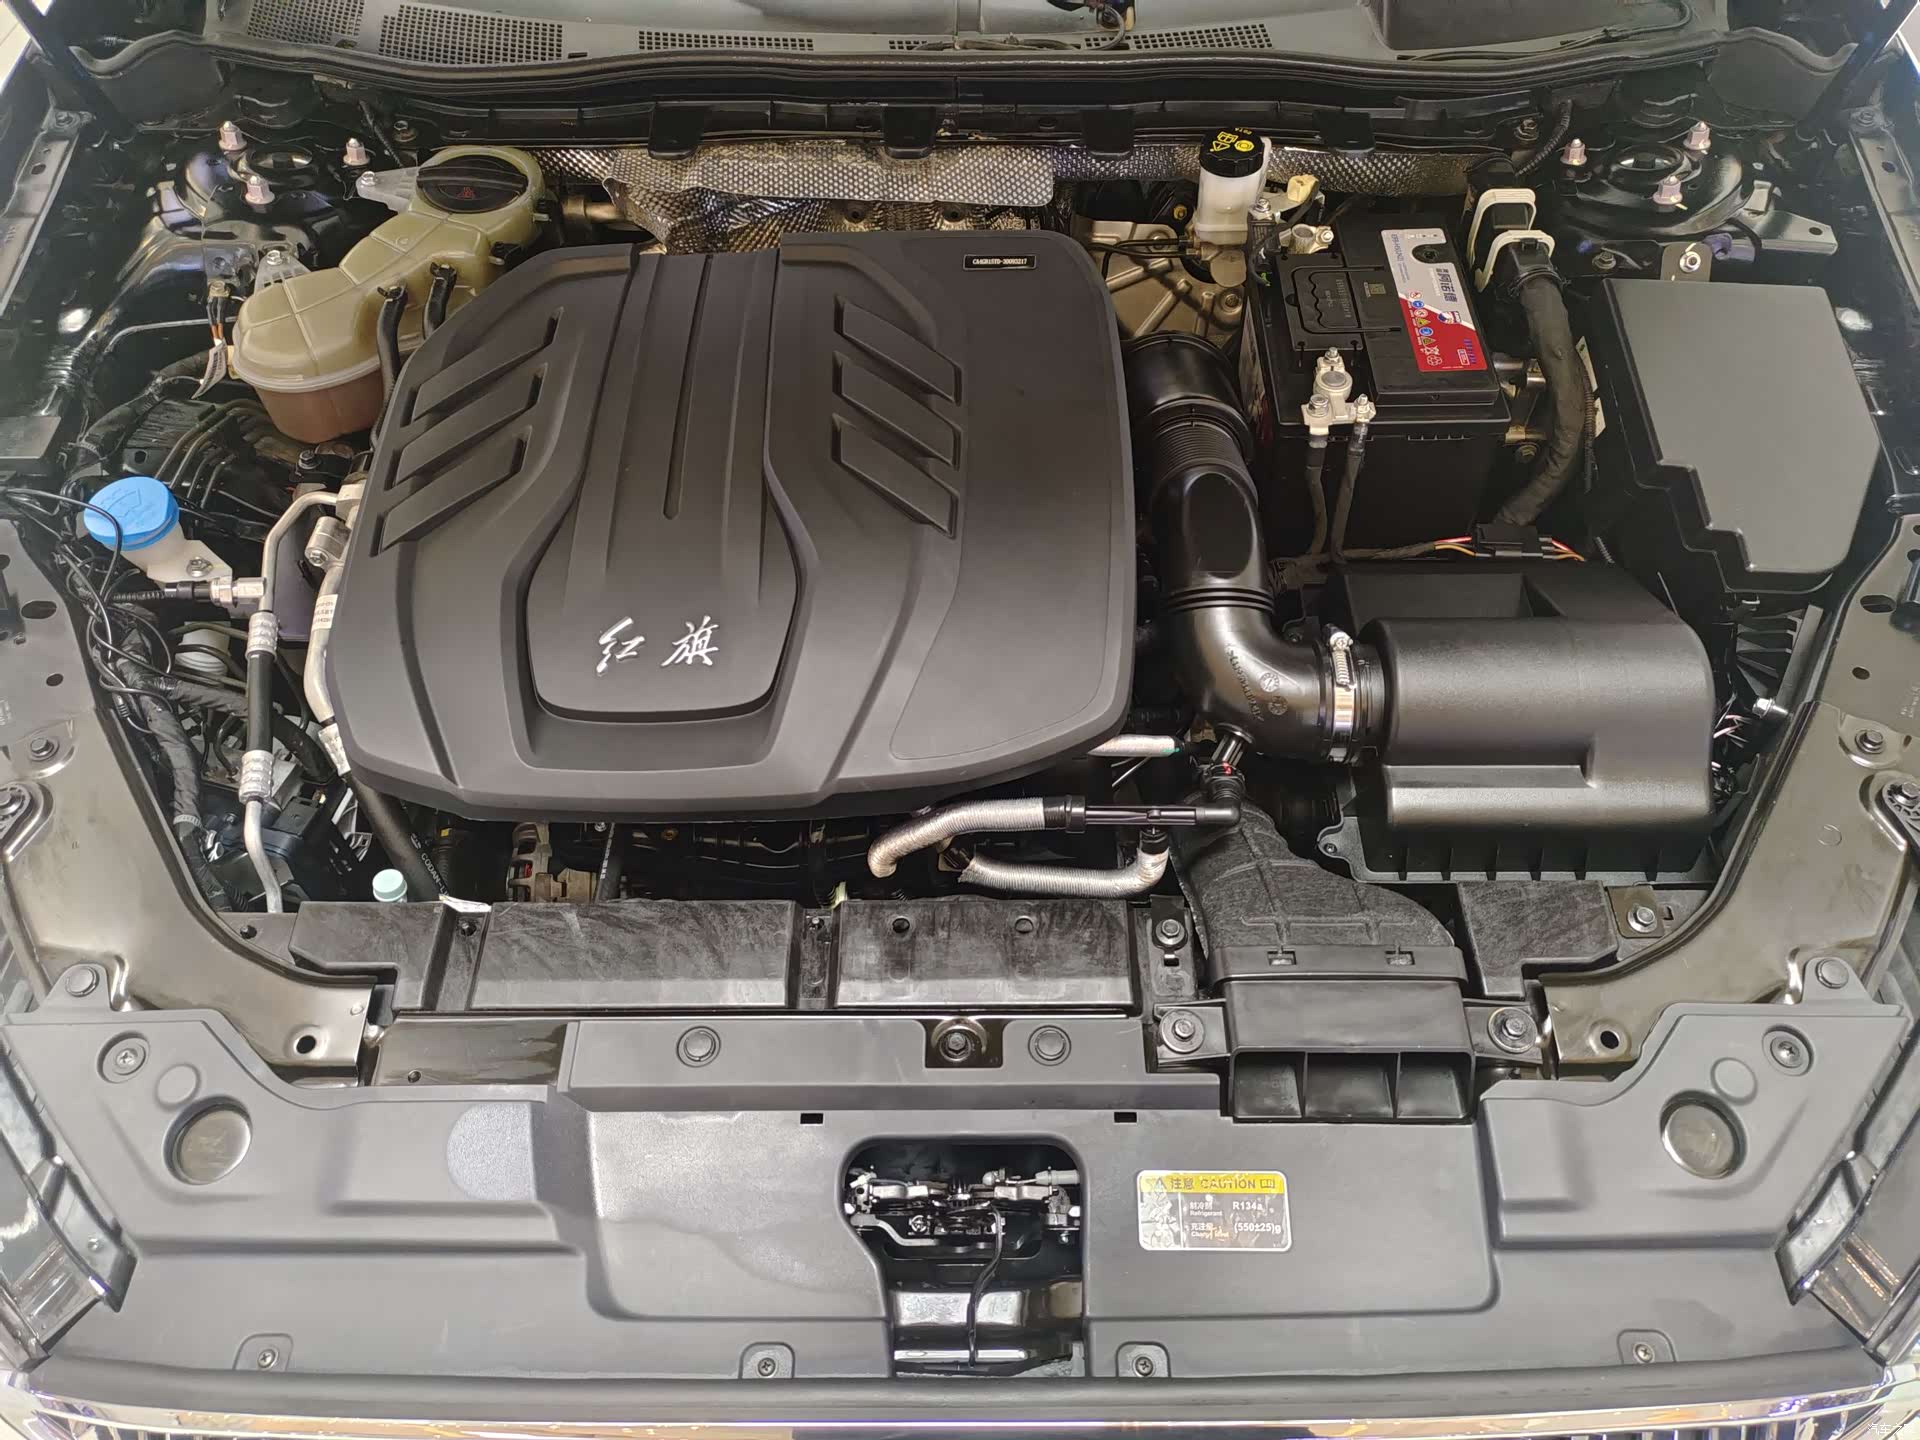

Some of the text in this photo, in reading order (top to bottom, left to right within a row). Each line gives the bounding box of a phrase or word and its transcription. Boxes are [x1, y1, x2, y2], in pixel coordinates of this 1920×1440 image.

[1170, 1177, 1256, 1190] 注意 CAUTION
[1233, 1201, 1263, 1210] R134a
[1190, 1210, 1223, 1218] Refrigerant
[1234, 1223, 1282, 1234] (550±25)g
